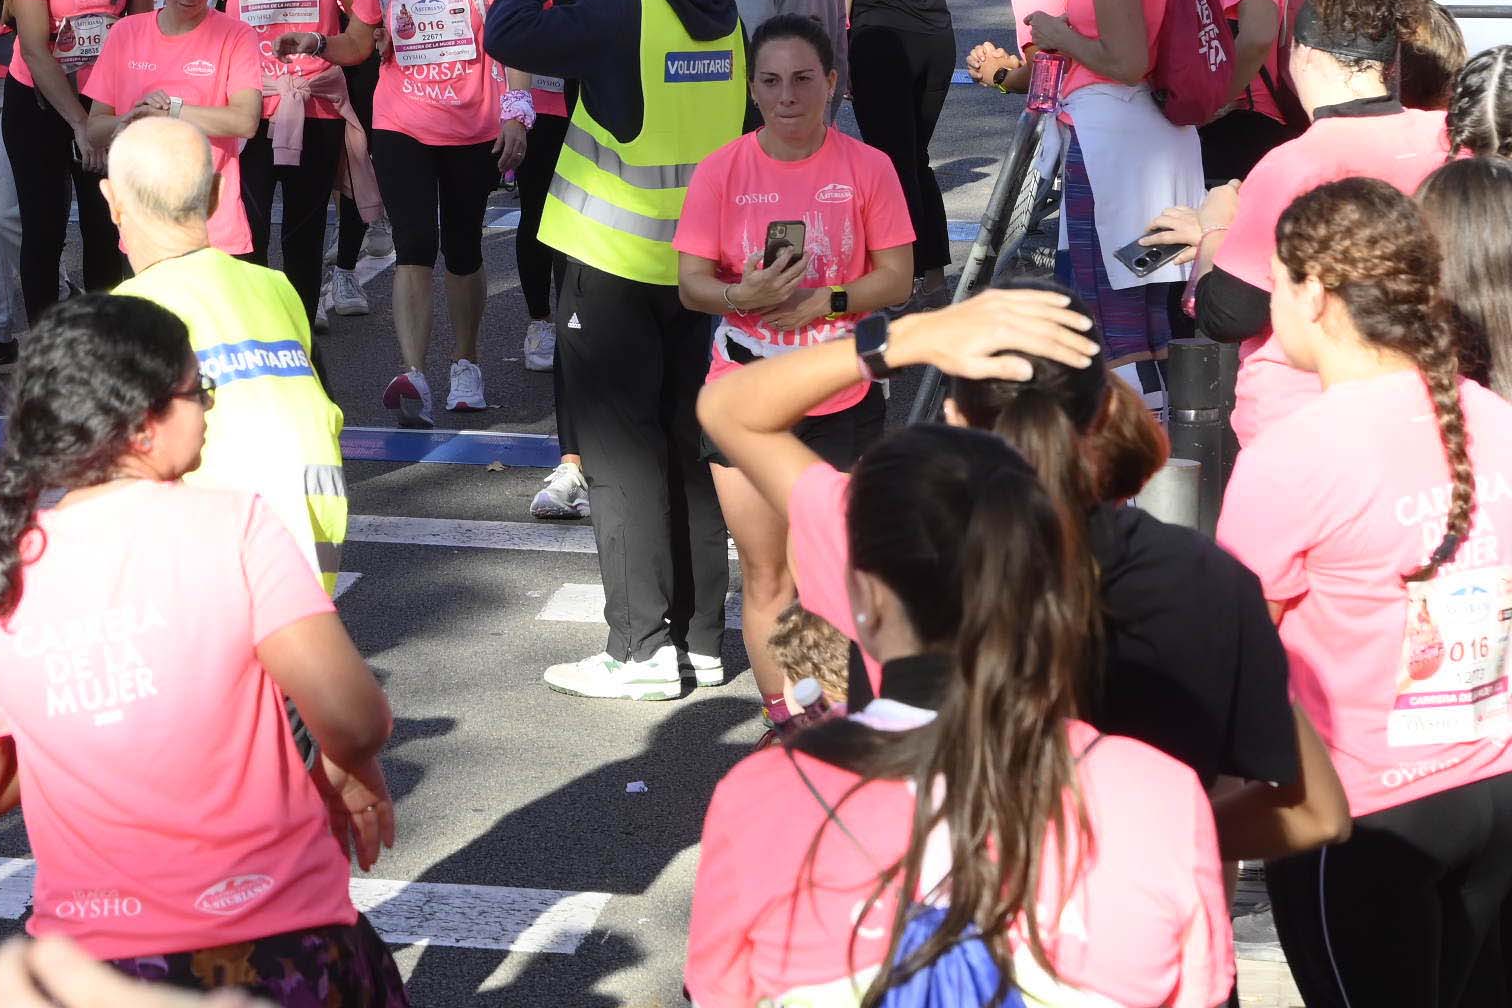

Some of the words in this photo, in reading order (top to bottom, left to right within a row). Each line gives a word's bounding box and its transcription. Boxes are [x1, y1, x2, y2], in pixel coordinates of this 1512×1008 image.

[418, 20, 445, 32] 016
[78, 34, 101, 46] 016
[667, 58, 731, 76] VOLUNTARIS
[402, 78, 458, 100] SUMA
[736, 192, 779, 206] OYSHO
[1449, 635, 1489, 663] 016
[46, 666, 159, 719] MUJER
[55, 895, 143, 920] OYSHO
